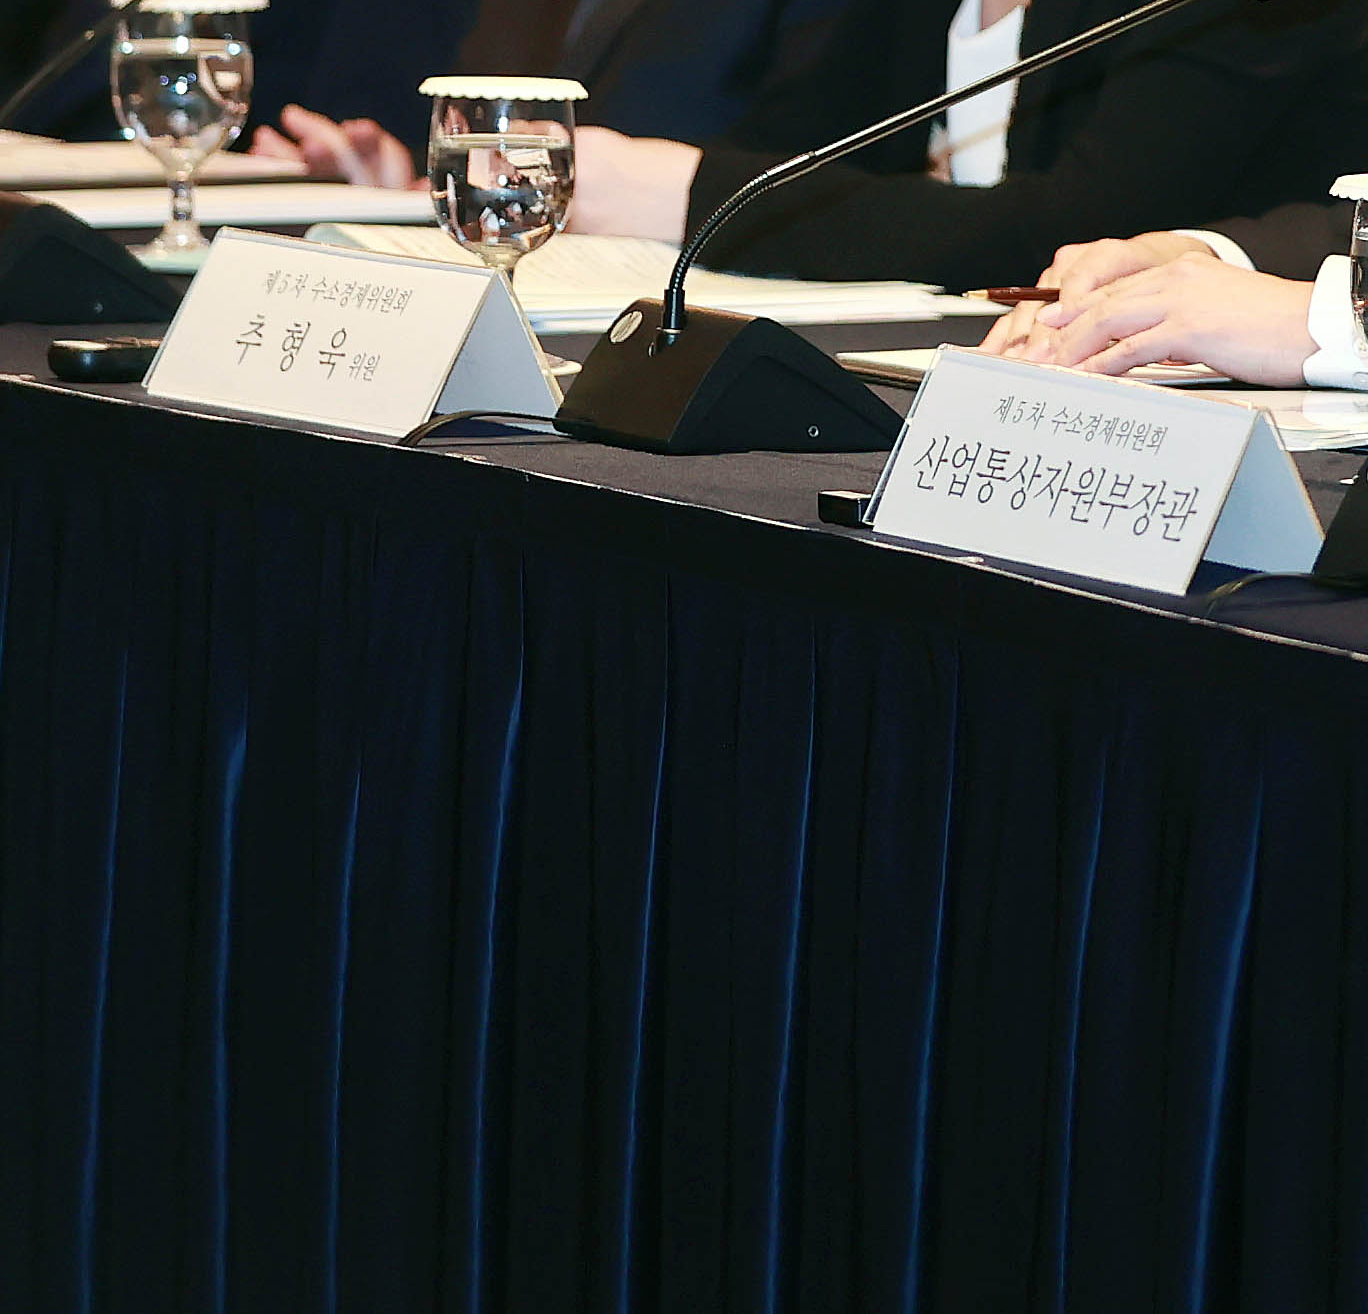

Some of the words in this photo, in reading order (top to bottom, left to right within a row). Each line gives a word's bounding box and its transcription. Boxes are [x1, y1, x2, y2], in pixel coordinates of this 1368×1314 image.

[264, 269, 306, 294] 제5차
[312, 277, 413, 314] 수소경제위원회
[348, 352, 381, 382] 위원
[993, 394, 1046, 431] 제5차
[1050, 407, 1169, 455] 수소경제위원회
[913, 434, 1200, 543] 산업통상자원부장관
